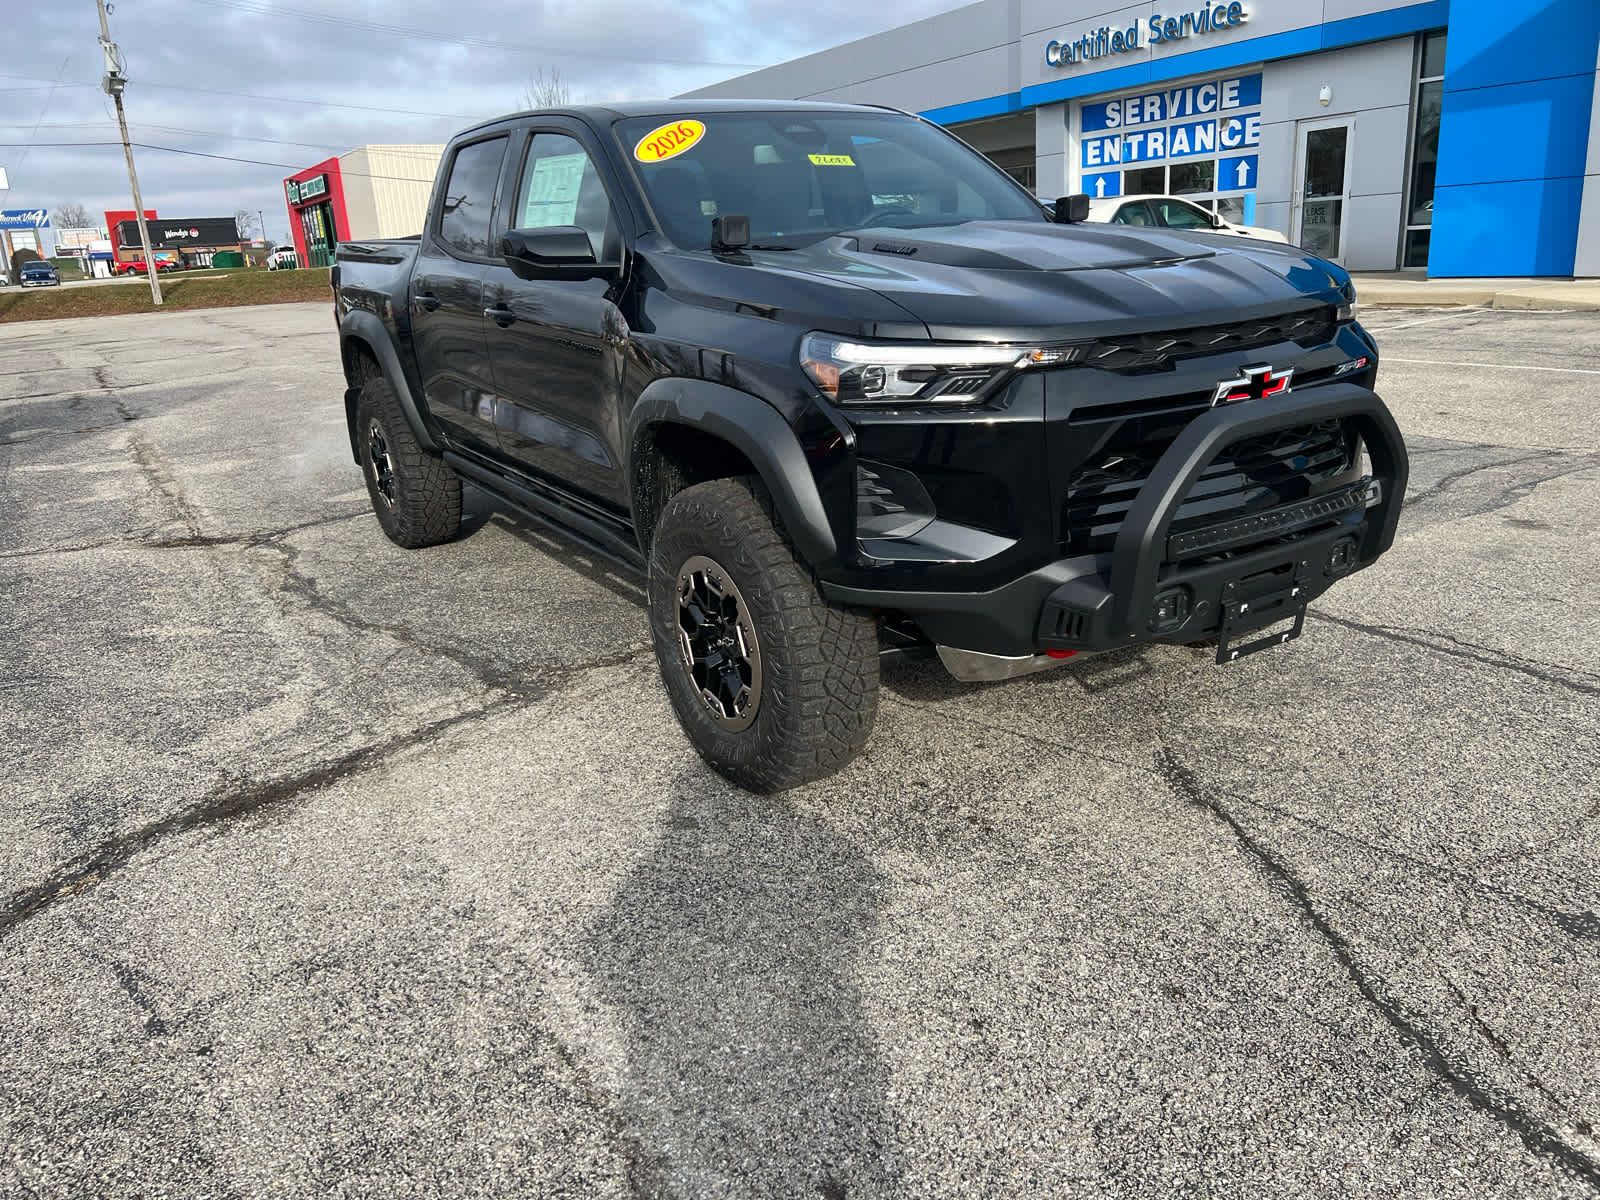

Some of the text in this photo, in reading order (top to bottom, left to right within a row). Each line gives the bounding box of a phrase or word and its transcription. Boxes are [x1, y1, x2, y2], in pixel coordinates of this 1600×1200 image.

[1046, 0, 1243, 67] Certified Service
[1105, 80, 1240, 128] SERVICE
[646, 123, 695, 158] 2026
[1087, 116, 1261, 166] ENTRANCE
[164, 228, 189, 239] Wendy's
